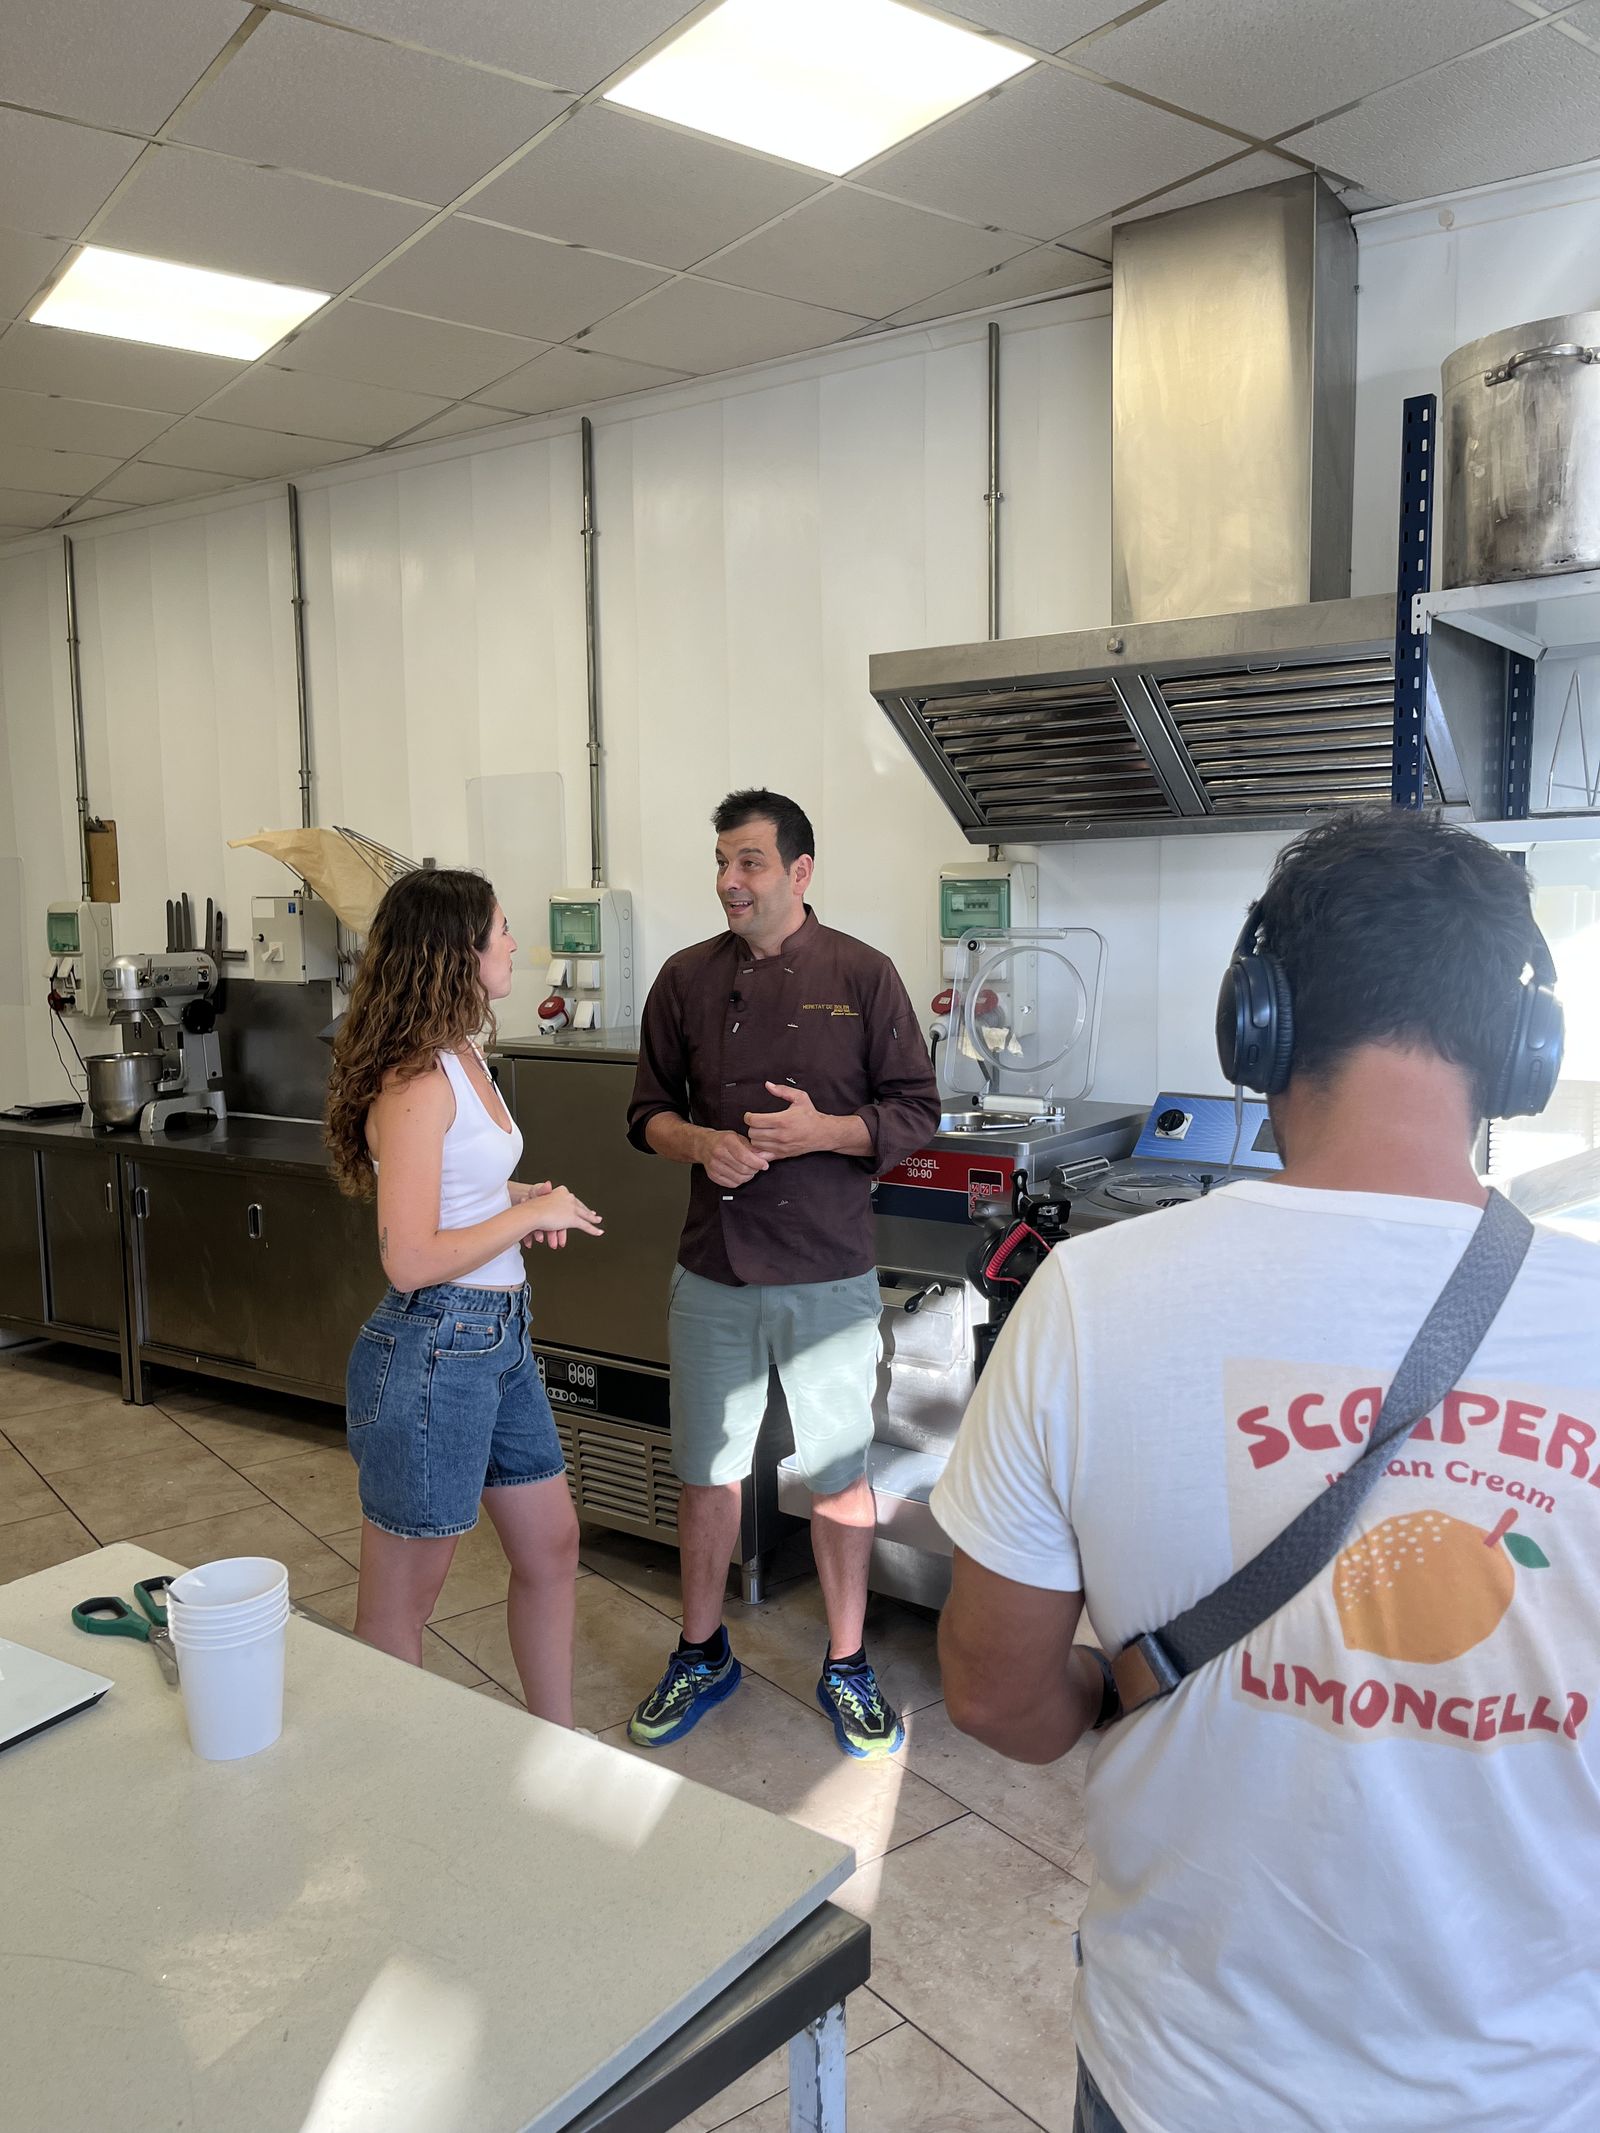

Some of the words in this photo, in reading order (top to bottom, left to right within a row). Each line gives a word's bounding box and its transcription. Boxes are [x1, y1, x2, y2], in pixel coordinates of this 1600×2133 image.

[907, 1168, 932, 1179] 30-90
[1237, 1386, 1600, 1490] SCAPER
[1445, 1460, 1555, 1514] Cream
[1241, 1651, 1589, 1742] LIMONCELLO
